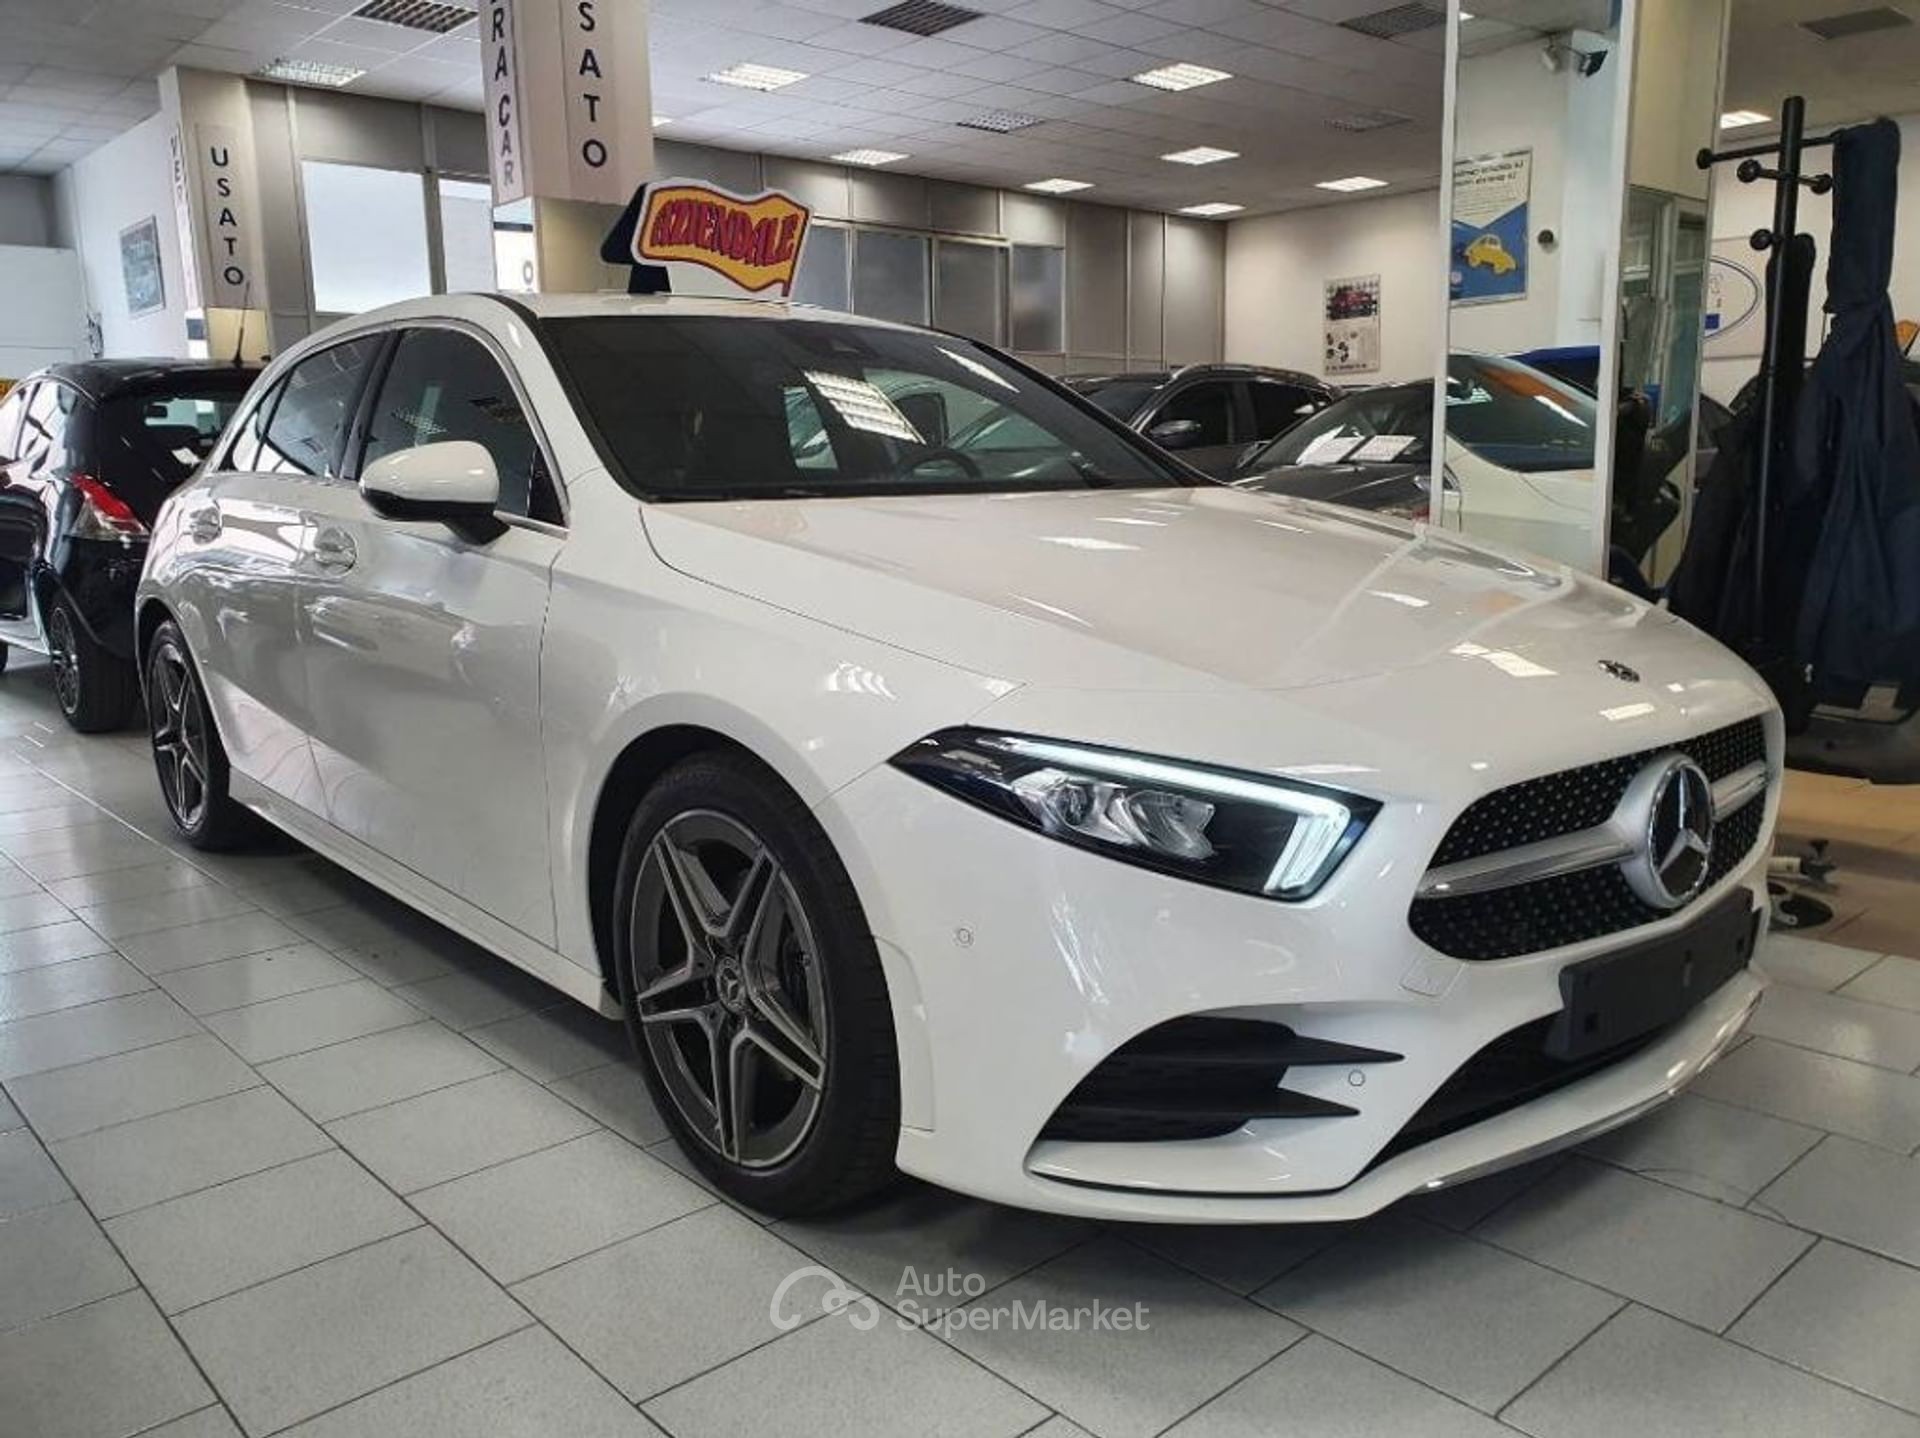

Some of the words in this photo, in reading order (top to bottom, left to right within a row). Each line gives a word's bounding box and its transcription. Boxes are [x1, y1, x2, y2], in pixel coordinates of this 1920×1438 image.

[490, 0, 508, 81] RA
[210, 147, 244, 285] USATO
[650, 198, 799, 267] AZIENDALE
